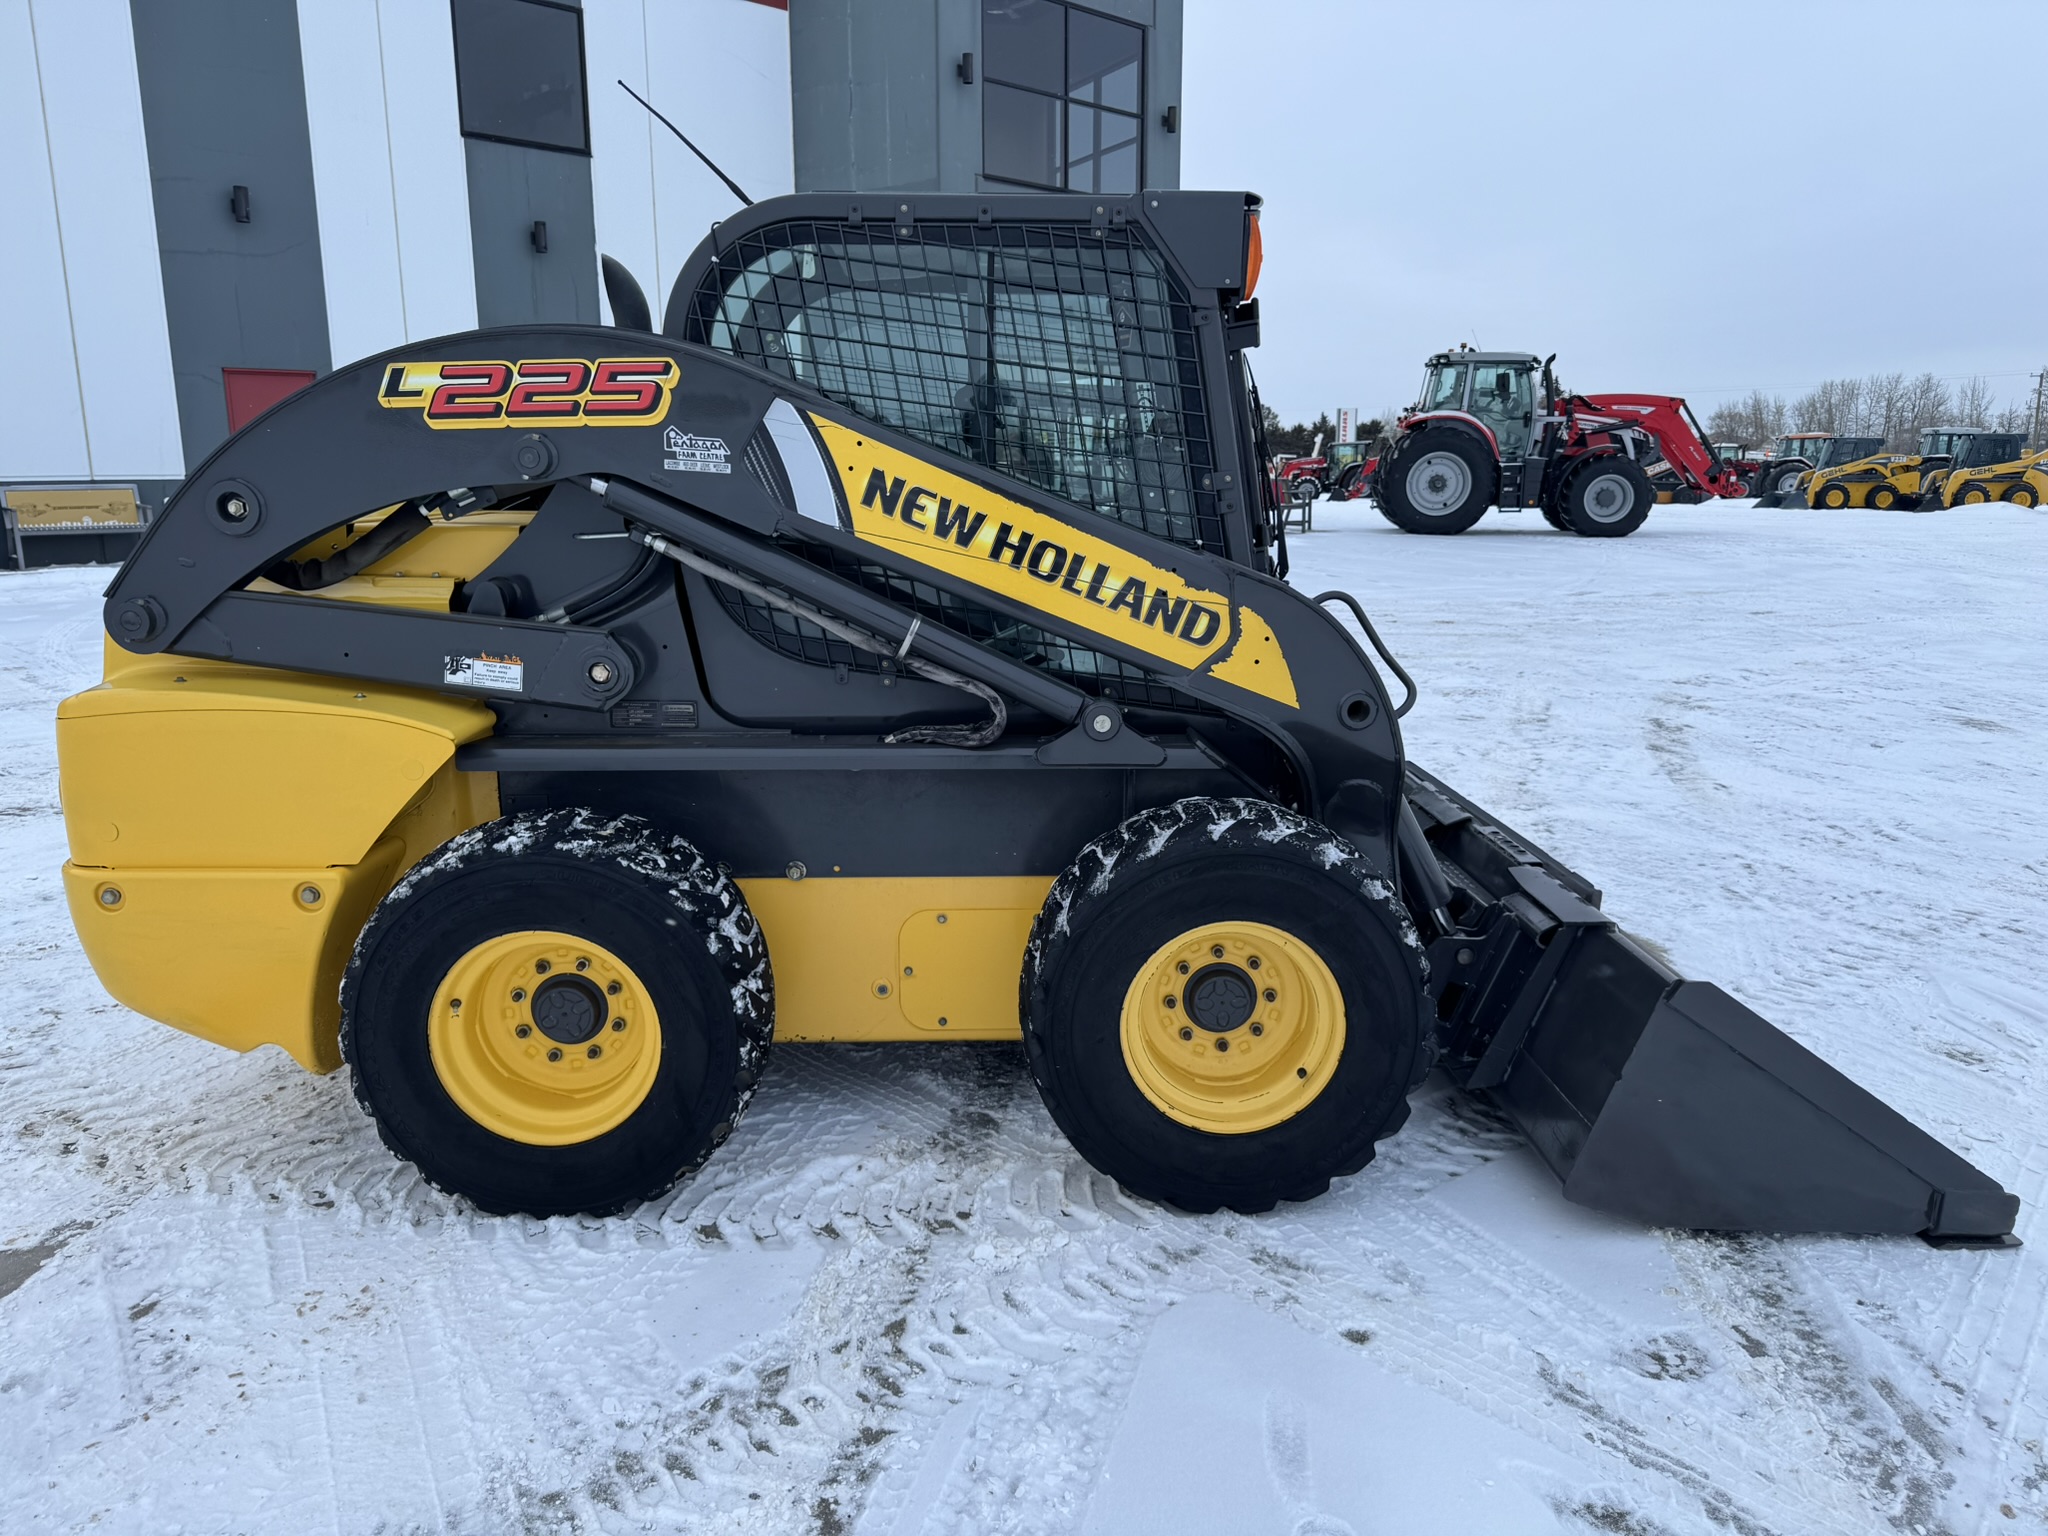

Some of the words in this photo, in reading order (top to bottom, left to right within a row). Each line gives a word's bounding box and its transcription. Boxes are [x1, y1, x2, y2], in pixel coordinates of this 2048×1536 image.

[380, 359, 677, 422] L225
[678, 451, 698, 459] FARM
[700, 452, 724, 461] CENTRE
[1821, 467, 1848, 479] GEHL
[1970, 467, 1997, 478] GEHL
[859, 466, 988, 550] NEW
[987, 520, 1223, 649] HOLLAND
